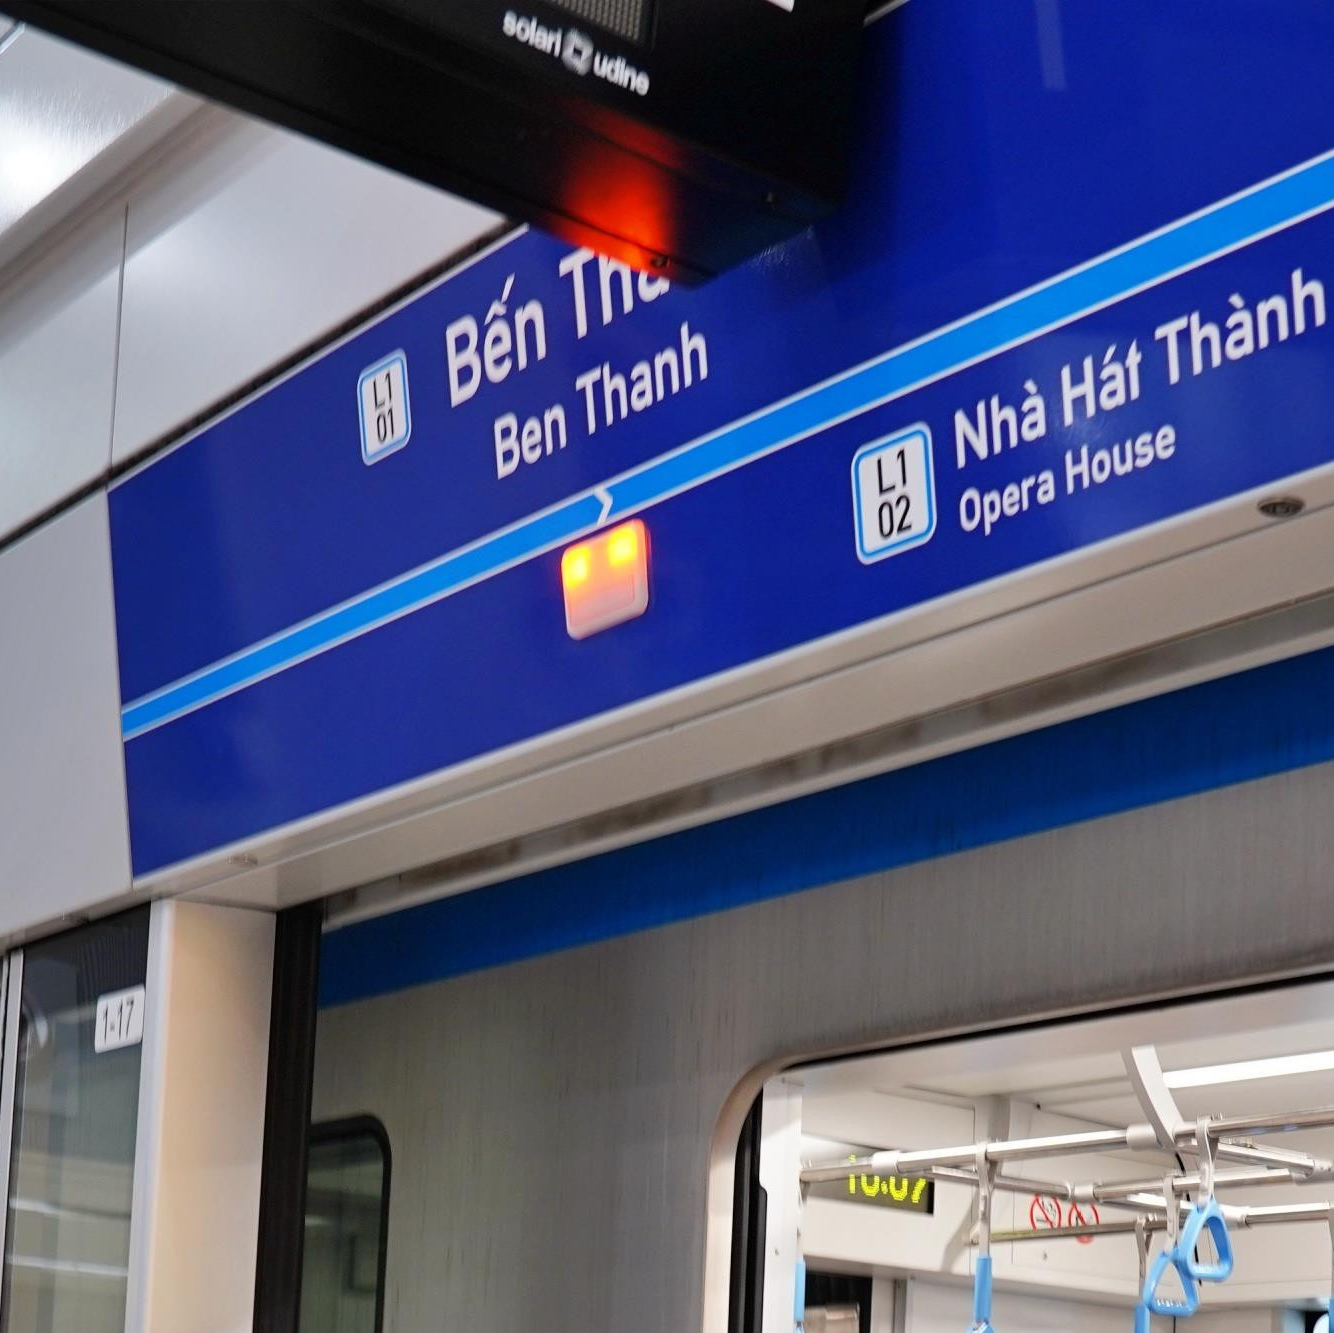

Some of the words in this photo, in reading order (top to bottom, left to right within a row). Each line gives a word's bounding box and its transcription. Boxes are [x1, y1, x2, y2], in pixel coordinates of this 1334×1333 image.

[502, 10, 563, 58] solari
[593, 51, 650, 96] udine
[446, 272, 546, 408] Bến
[953, 380, 1046, 469] Nhà
[1061, 338, 1142, 428] Hát
[1155, 269, 1327, 386] Thành
[373, 370, 393, 411] L1
[376, 407, 395, 444] 01
[494, 403, 567, 479] Ben
[575, 321, 708, 437] Thanh
[877, 448, 908, 496] L1
[959, 469, 1056, 537] Opera
[1065, 425, 1177, 494] House
[878, 494, 914, 541] 02
